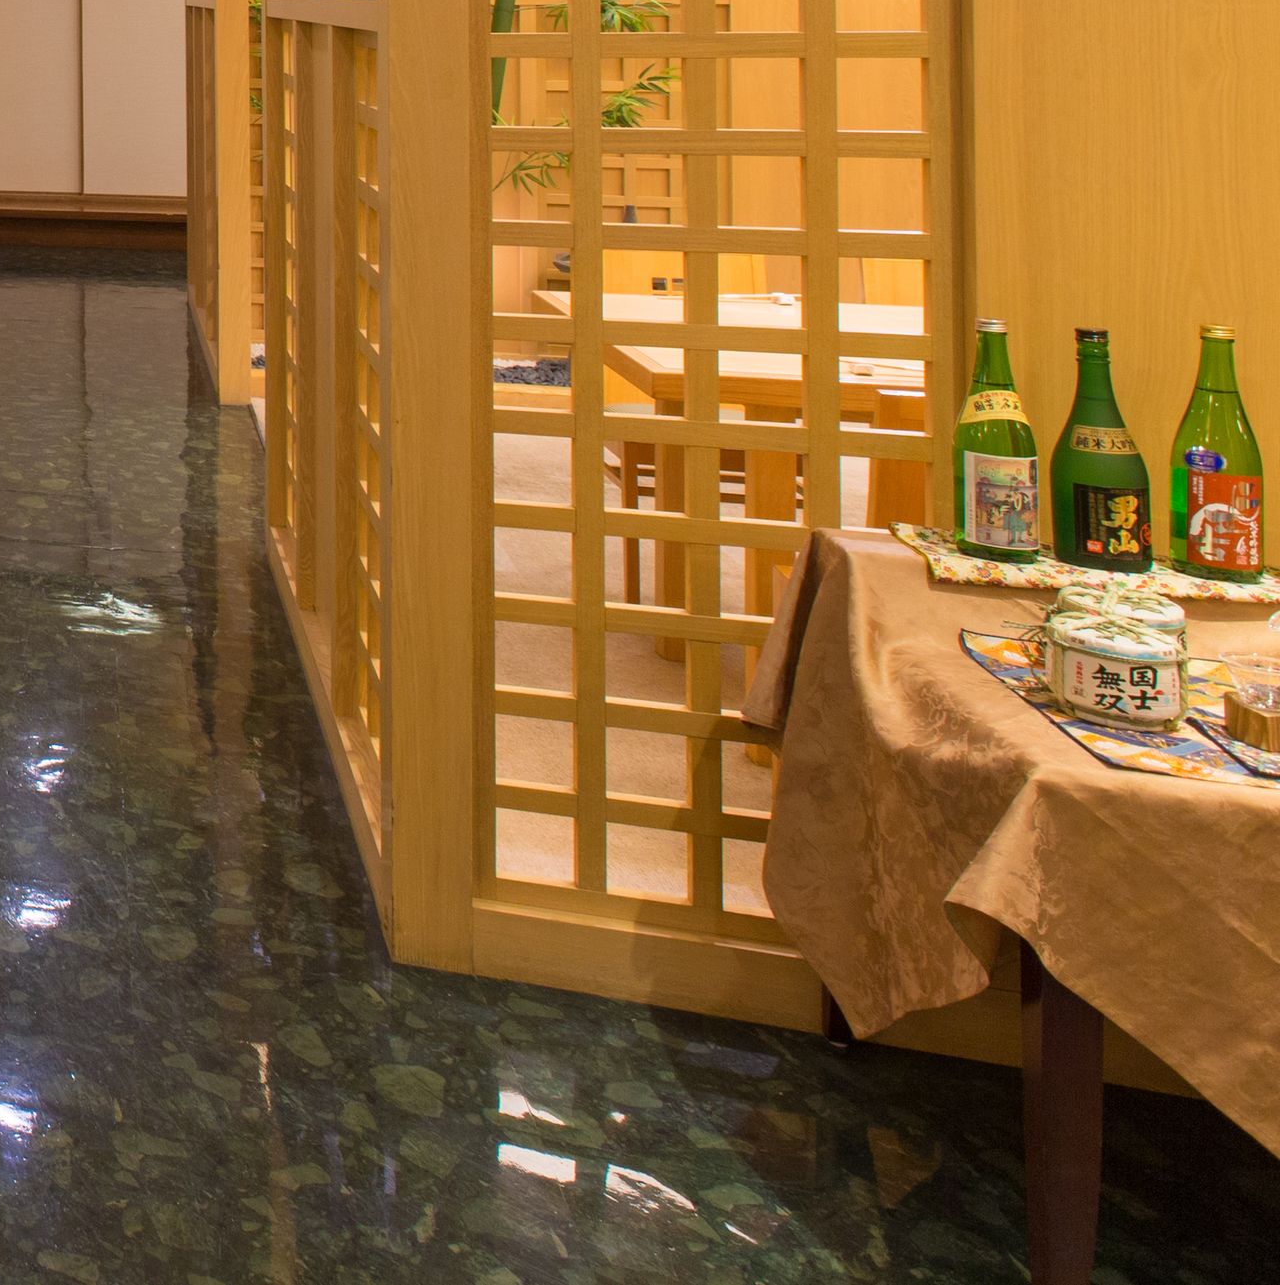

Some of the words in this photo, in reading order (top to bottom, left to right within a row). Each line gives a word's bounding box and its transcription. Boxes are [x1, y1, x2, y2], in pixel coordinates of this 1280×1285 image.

[1101, 495, 1139, 555] 男山
[1091, 663, 1129, 714] 無双
[1128, 665, 1159, 711] 国士
